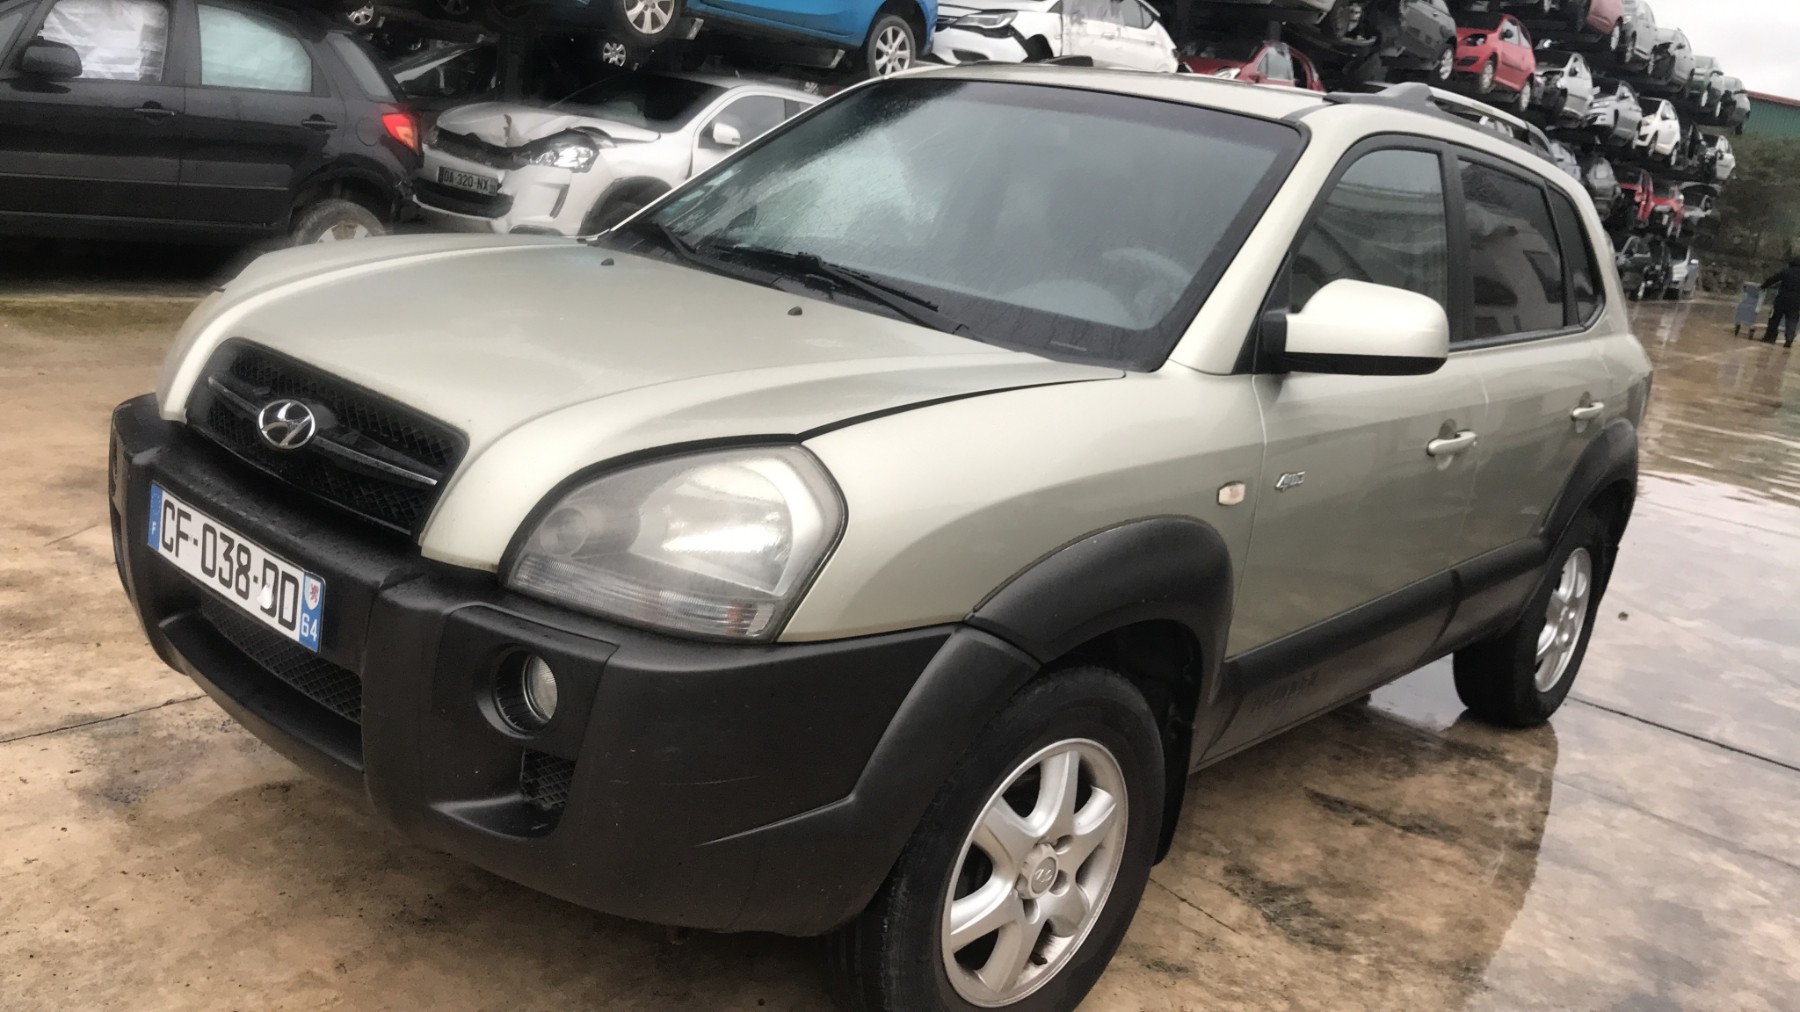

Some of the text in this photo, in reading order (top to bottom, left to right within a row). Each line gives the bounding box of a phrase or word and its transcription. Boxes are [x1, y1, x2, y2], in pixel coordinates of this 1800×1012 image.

[151, 521, 157, 535] F
[162, 499, 299, 632] CF-038-DD
[301, 613, 318, 642] 64
